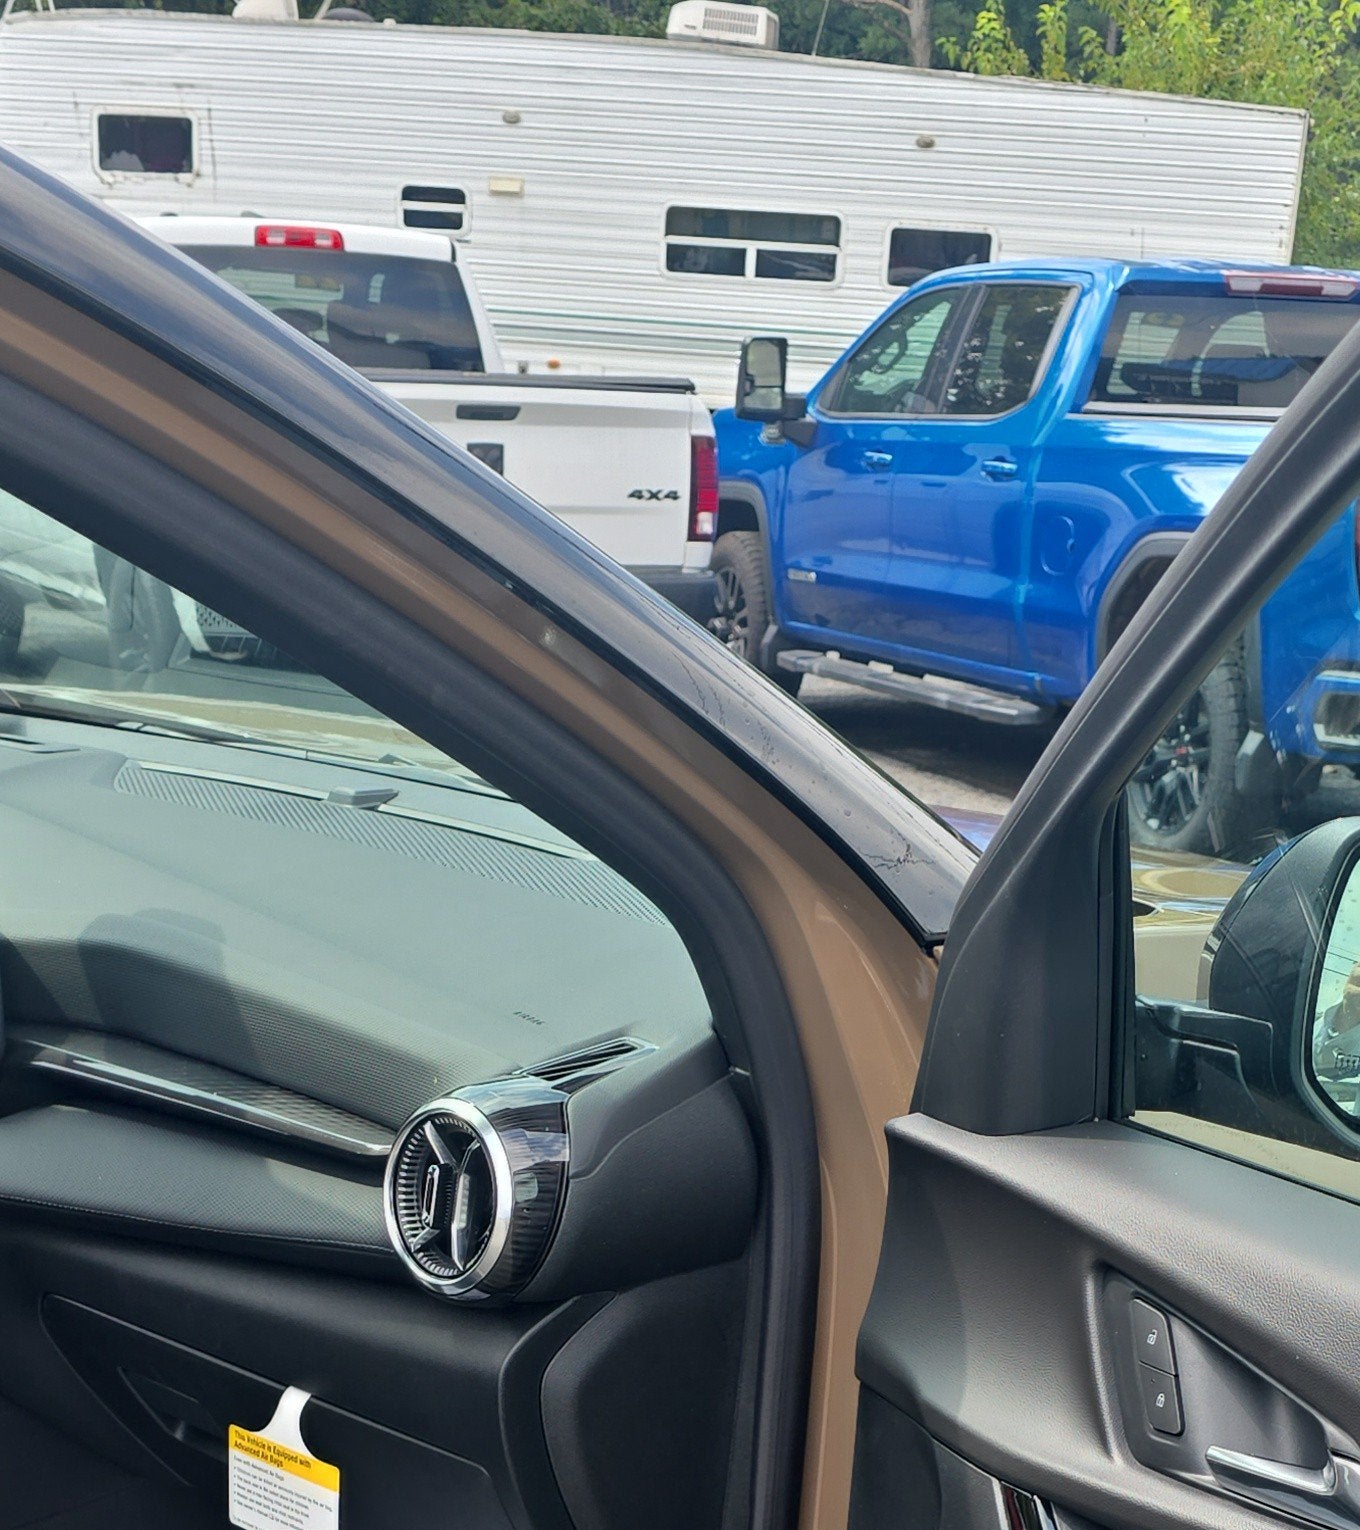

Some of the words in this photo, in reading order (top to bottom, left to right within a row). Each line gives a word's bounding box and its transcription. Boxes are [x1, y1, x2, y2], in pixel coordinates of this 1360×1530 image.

[626, 488, 681, 501] 4X4
[234, 1440, 260, 1458] Advanced
[273, 1445, 299, 1463] Equipped
